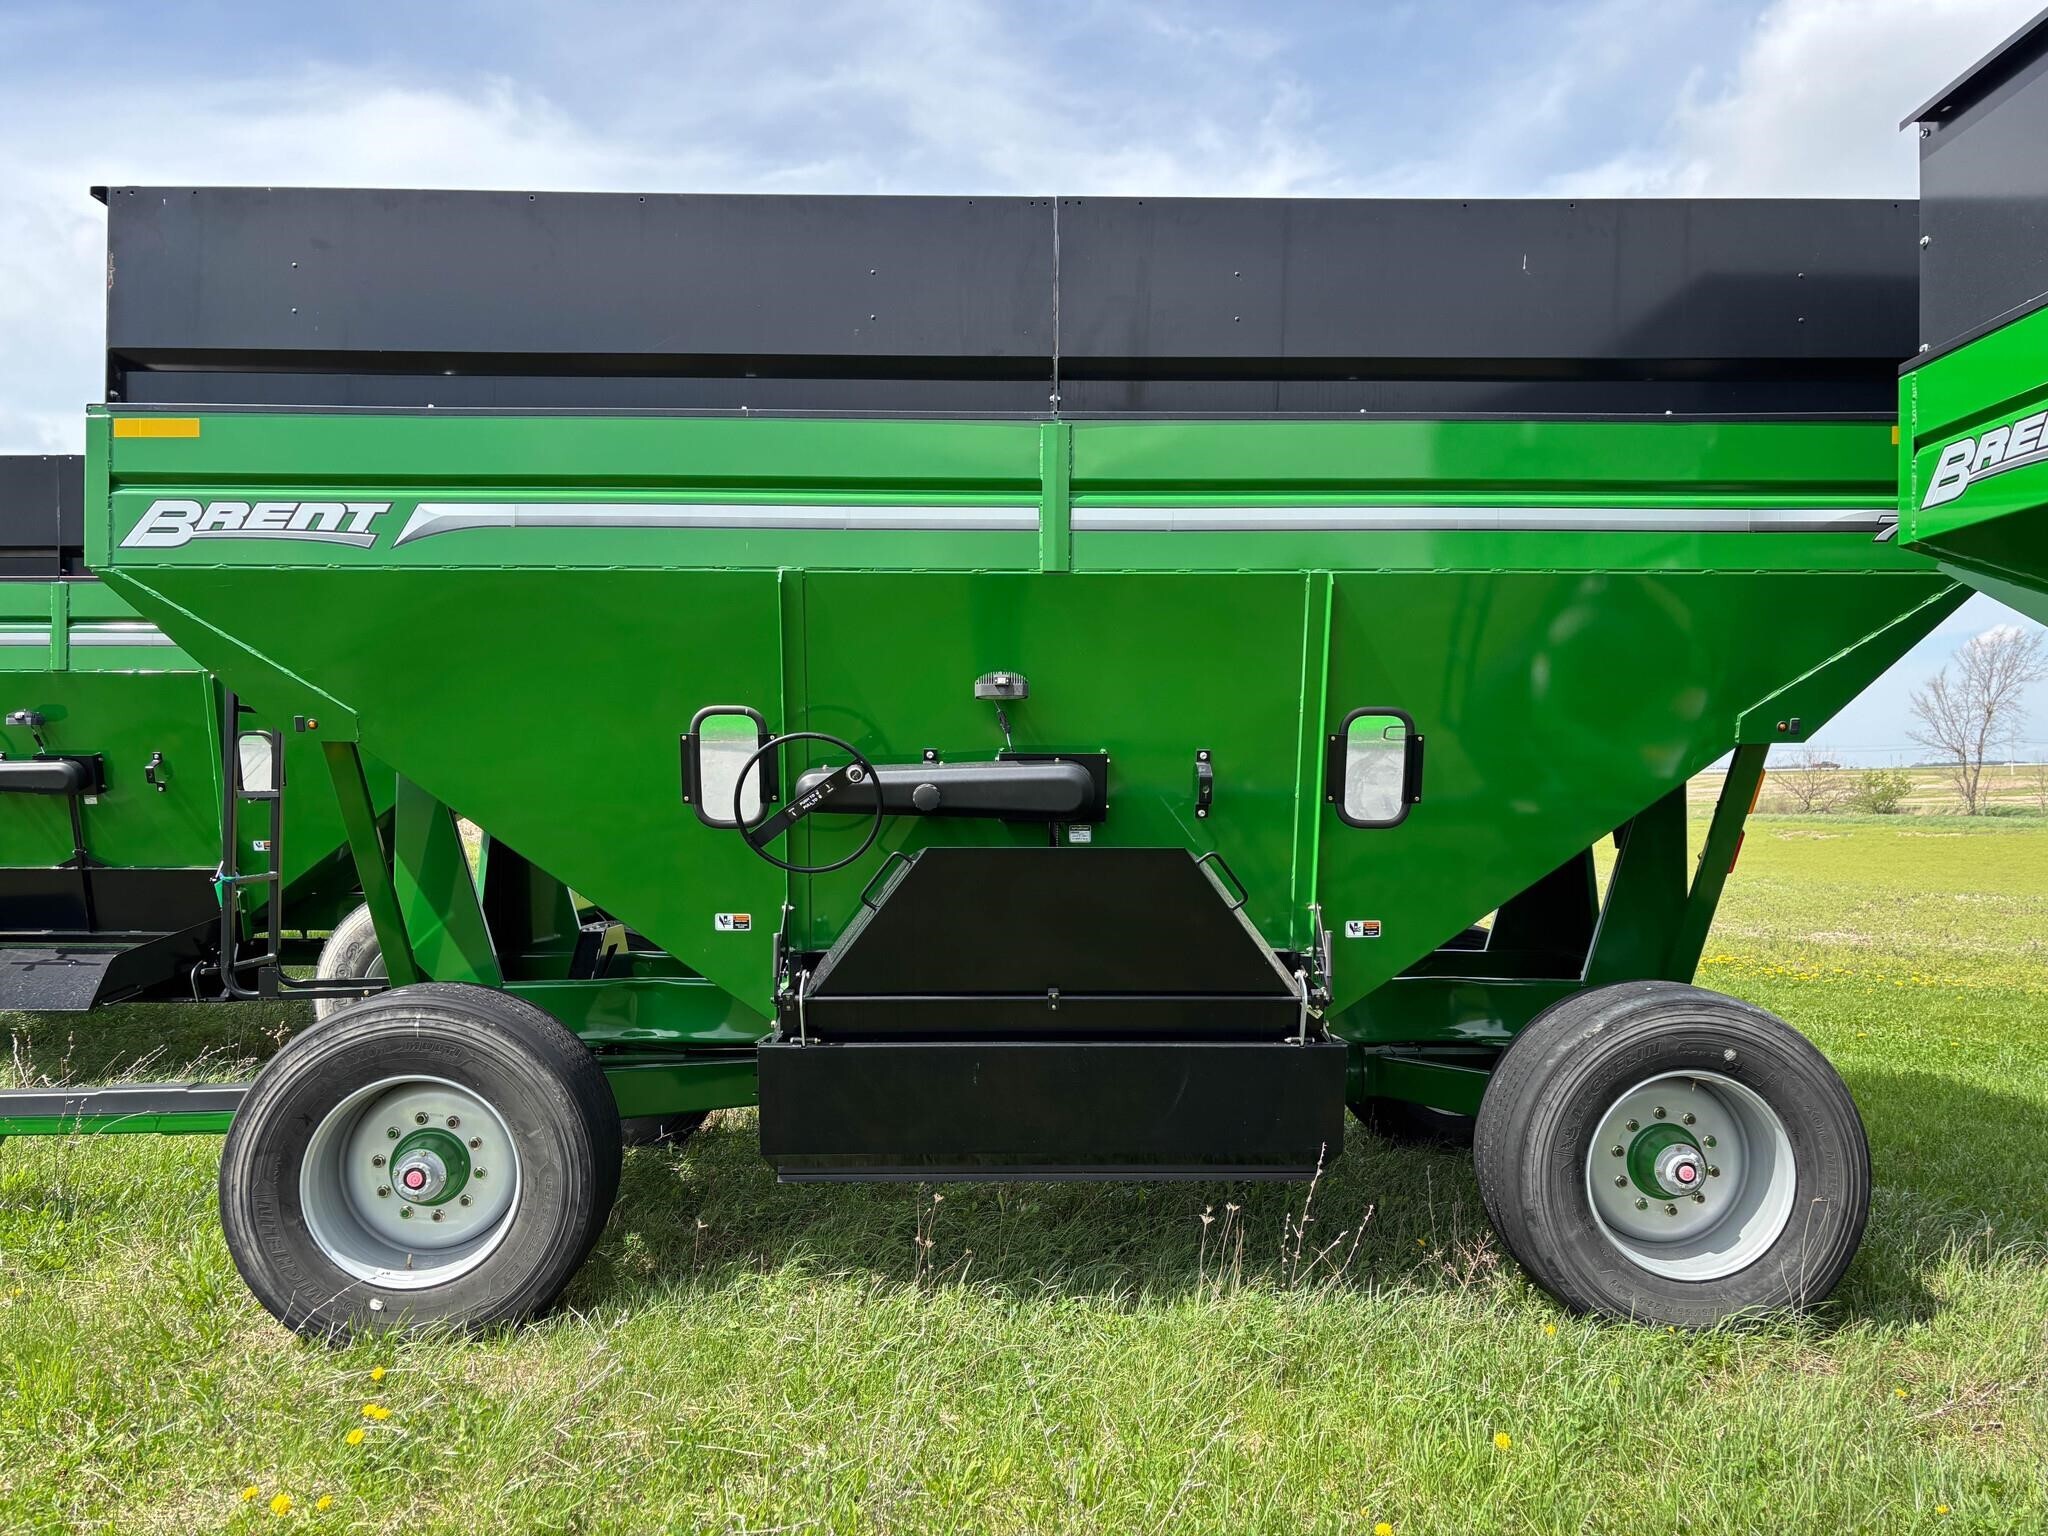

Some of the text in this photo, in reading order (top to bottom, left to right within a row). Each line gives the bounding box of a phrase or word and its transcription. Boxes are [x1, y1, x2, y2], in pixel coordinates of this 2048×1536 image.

[1919, 410, 2048, 511] BRE
[118, 499, 393, 548] BRENT
[256, 1199, 329, 1304] MICHELIN
